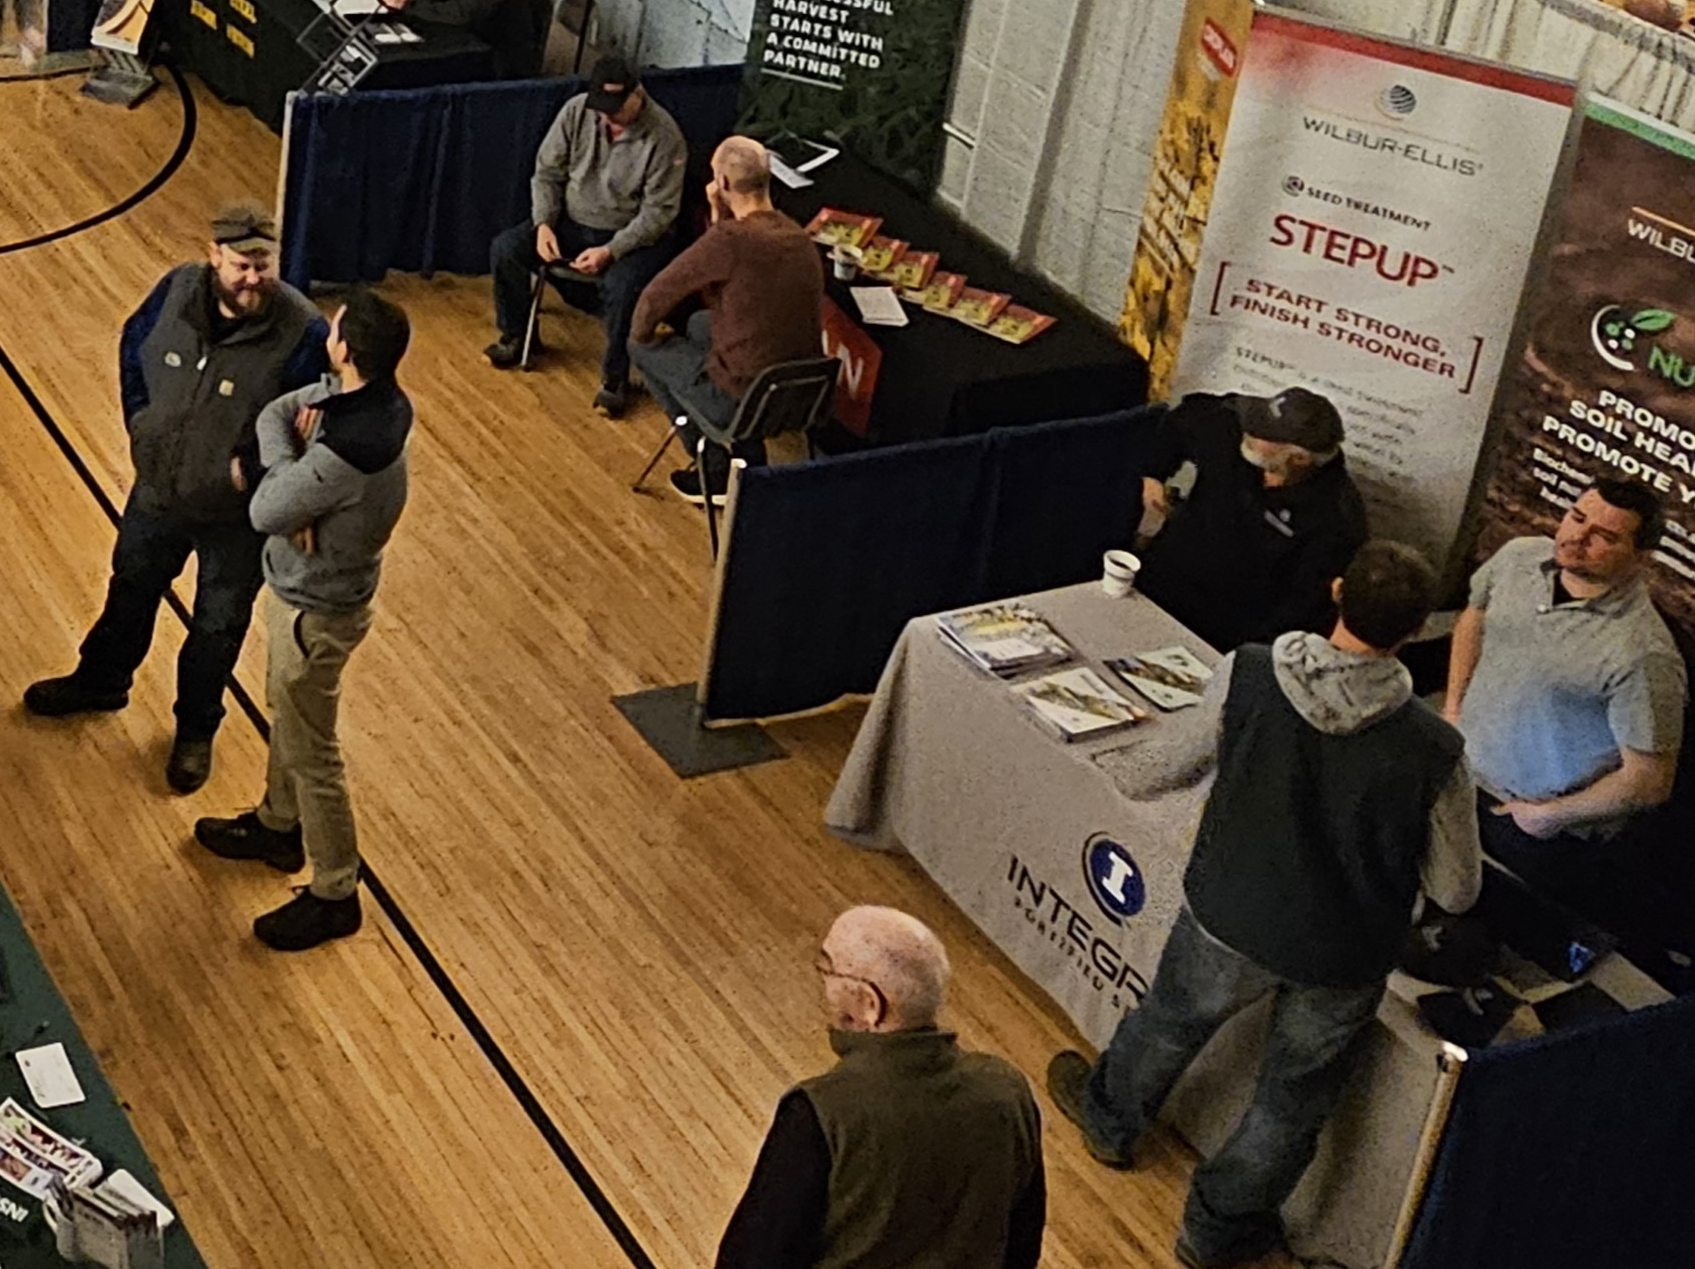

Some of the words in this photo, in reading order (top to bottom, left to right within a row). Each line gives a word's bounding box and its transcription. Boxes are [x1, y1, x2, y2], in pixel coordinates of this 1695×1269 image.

[763, 49, 847, 80] PARTNER.
[766, 32, 779, 46] A
[782, 35, 881, 69] COMMITTED
[770, 13, 832, 39] STARTS
[837, 27, 884, 52] WITH
[1307, 186, 1343, 206] SEED
[1345, 197, 1432, 231] TREATMENT
[1269, 213, 1440, 287] STEPUP
[1229, 294, 1311, 330] FINISH
[1317, 321, 1457, 379] STRONGER
[1246, 279, 1329, 314] START
[1335, 307, 1447, 357] STRONG,
[1542, 415, 1673, 493] PROMOTE
[1569, 399, 1629, 442] SOIL
[1634, 431, 1695, 477] HEA
